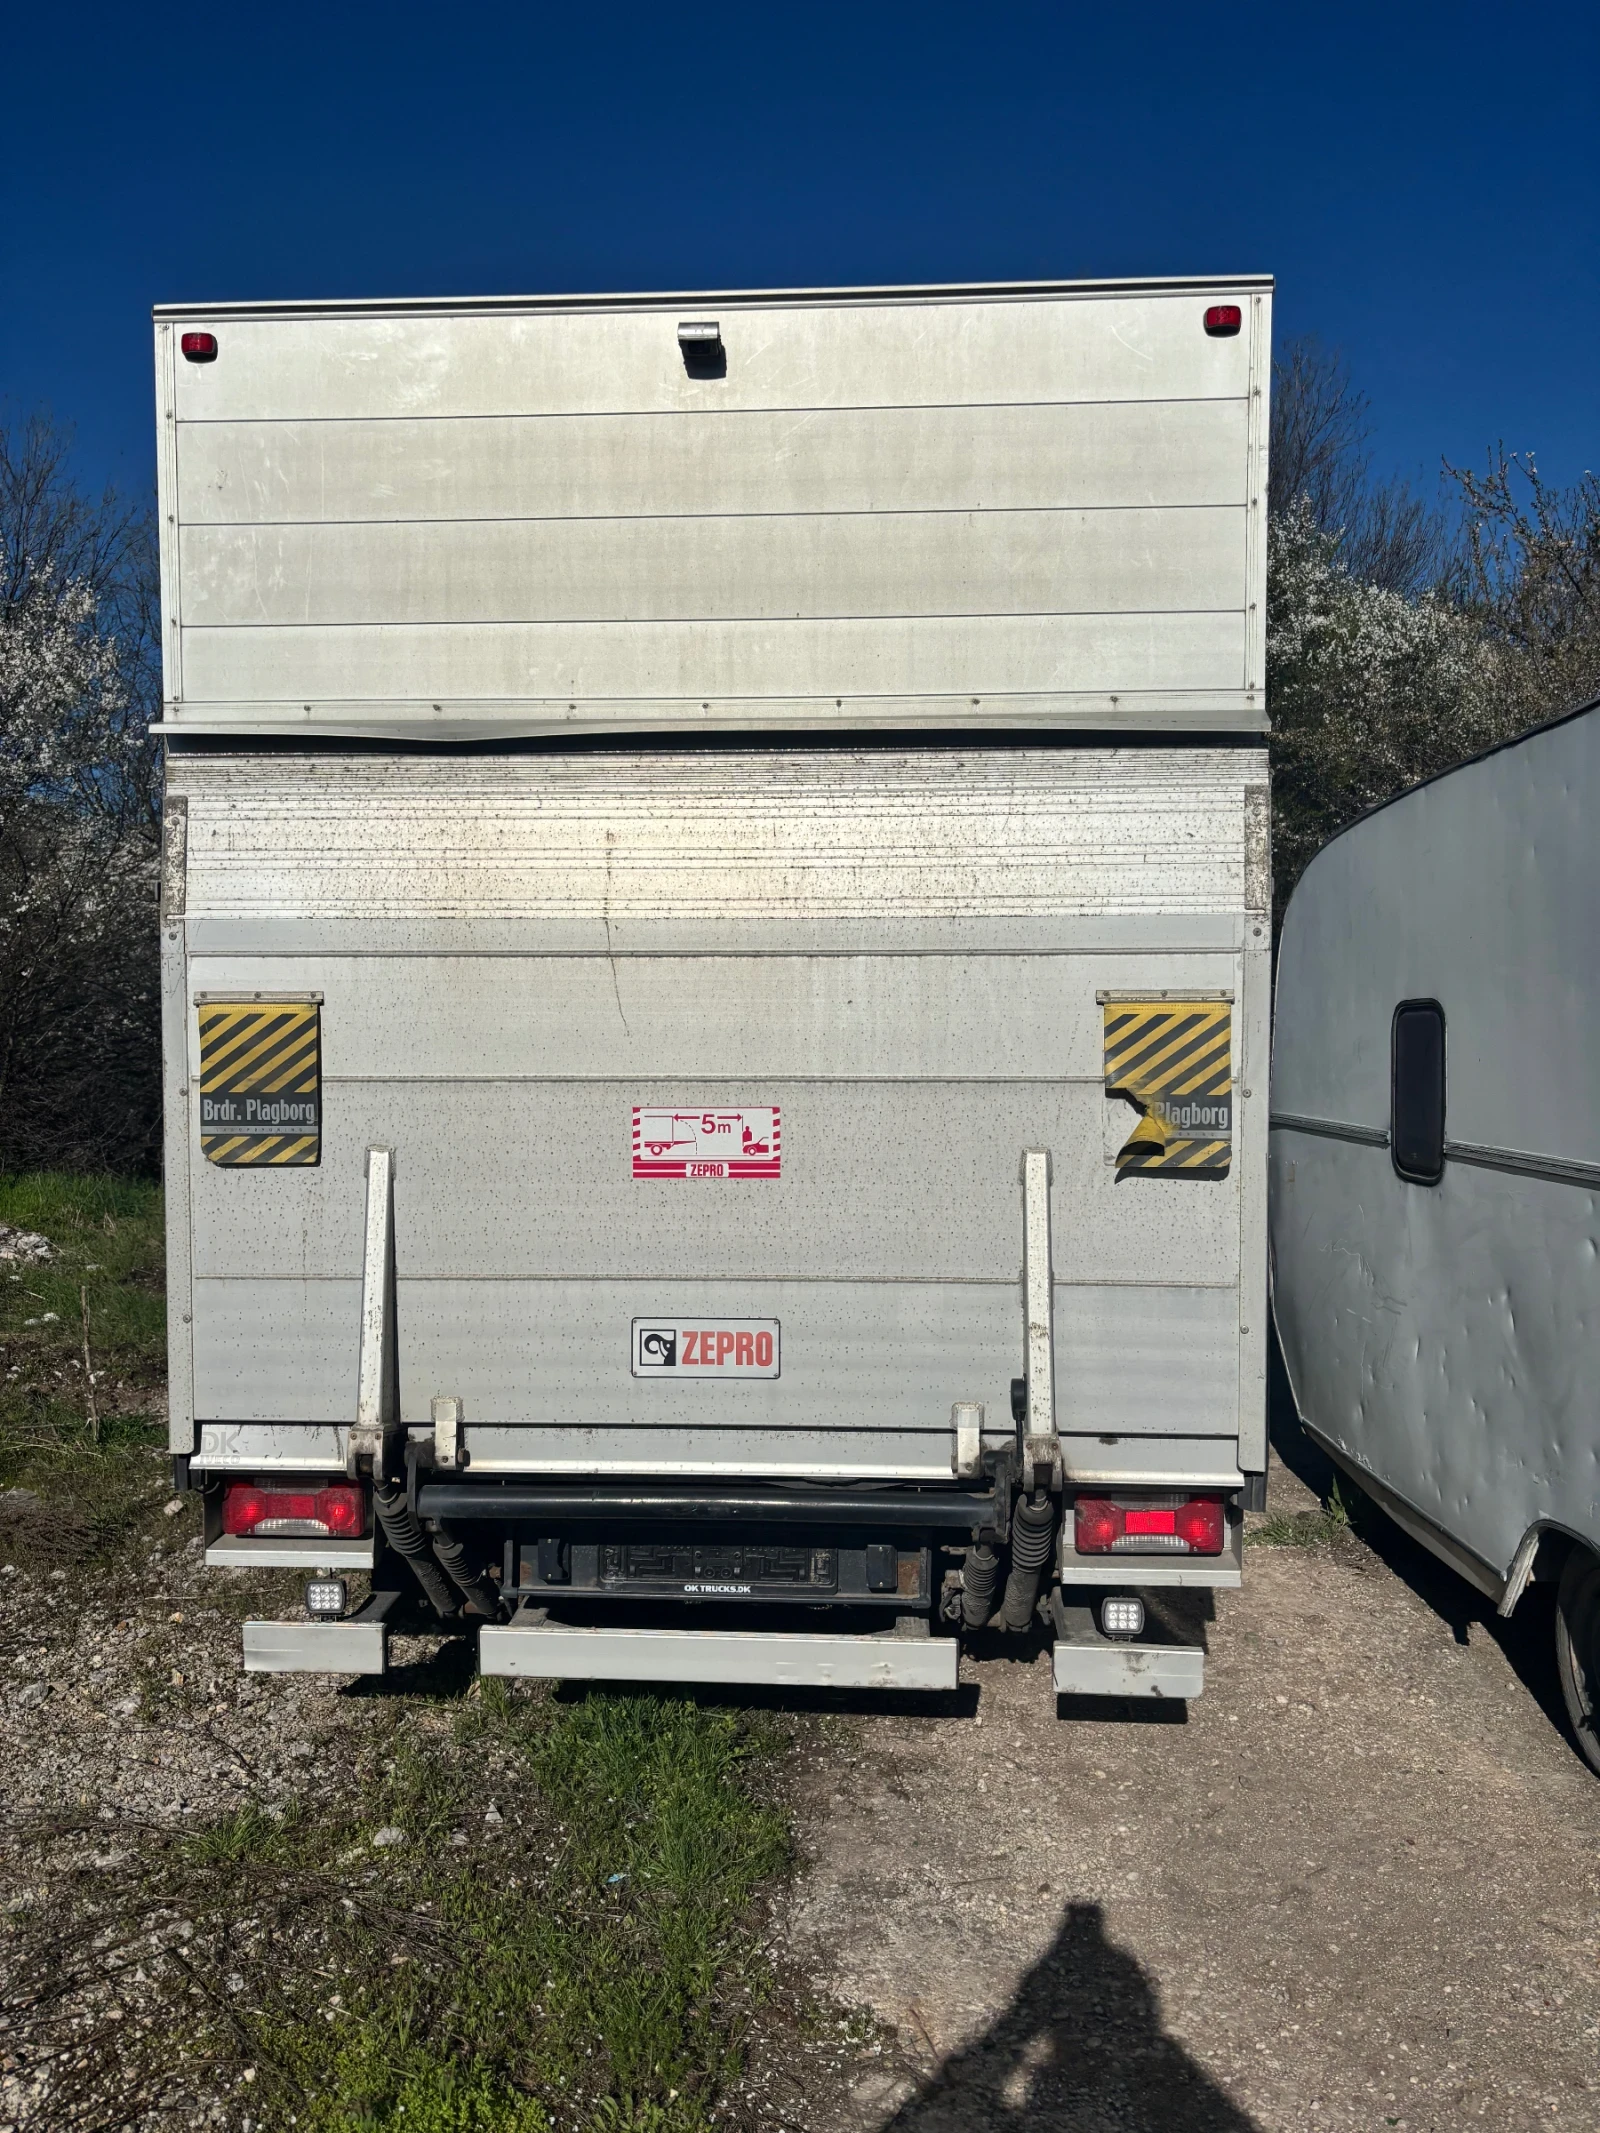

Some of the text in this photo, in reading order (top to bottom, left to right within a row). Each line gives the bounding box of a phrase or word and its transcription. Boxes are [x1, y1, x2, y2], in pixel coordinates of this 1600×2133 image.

[203, 1098, 315, 1124] Brdr. Plagborg
[690, 1164, 724, 1177] ZEPRO
[682, 1331, 773, 1366] ZEPRO
[684, 1584, 751, 1593] OK TRUCKS.DK
